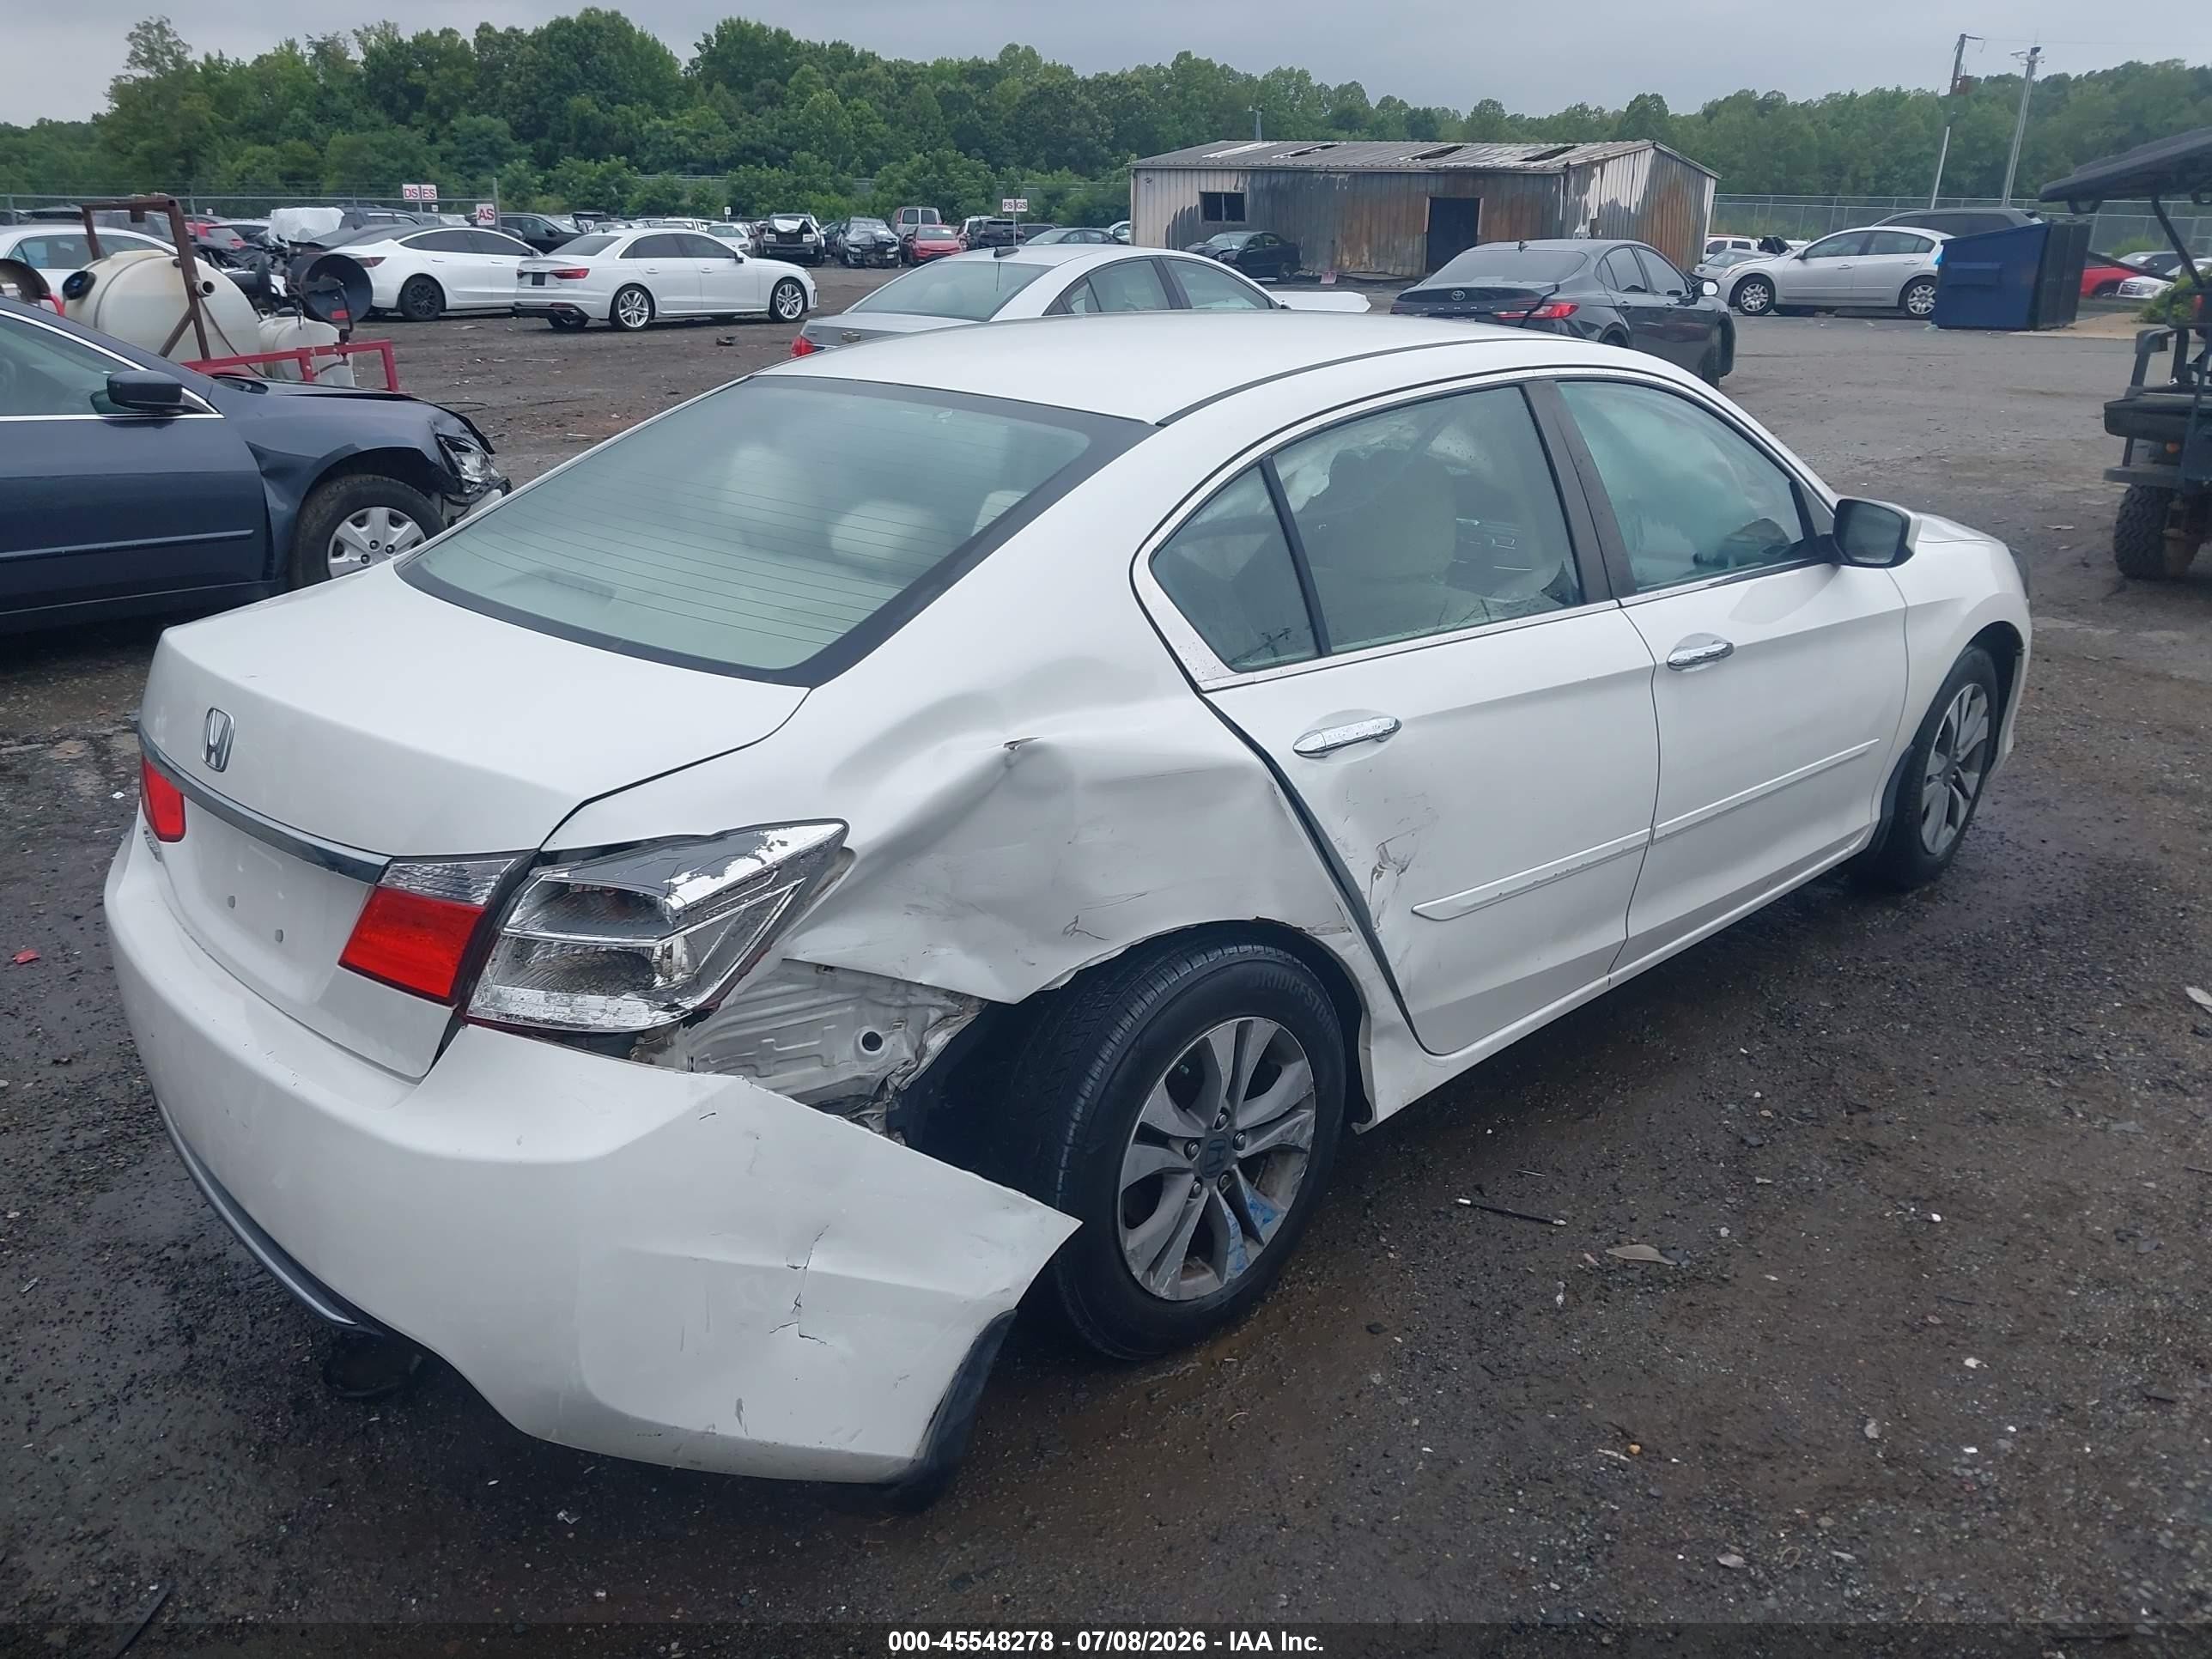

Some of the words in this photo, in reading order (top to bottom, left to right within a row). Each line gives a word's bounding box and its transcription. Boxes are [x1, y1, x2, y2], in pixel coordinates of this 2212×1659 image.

[404, 188, 418, 198] DS
[422, 188, 436, 198] ES
[477, 209, 495, 221] AS
